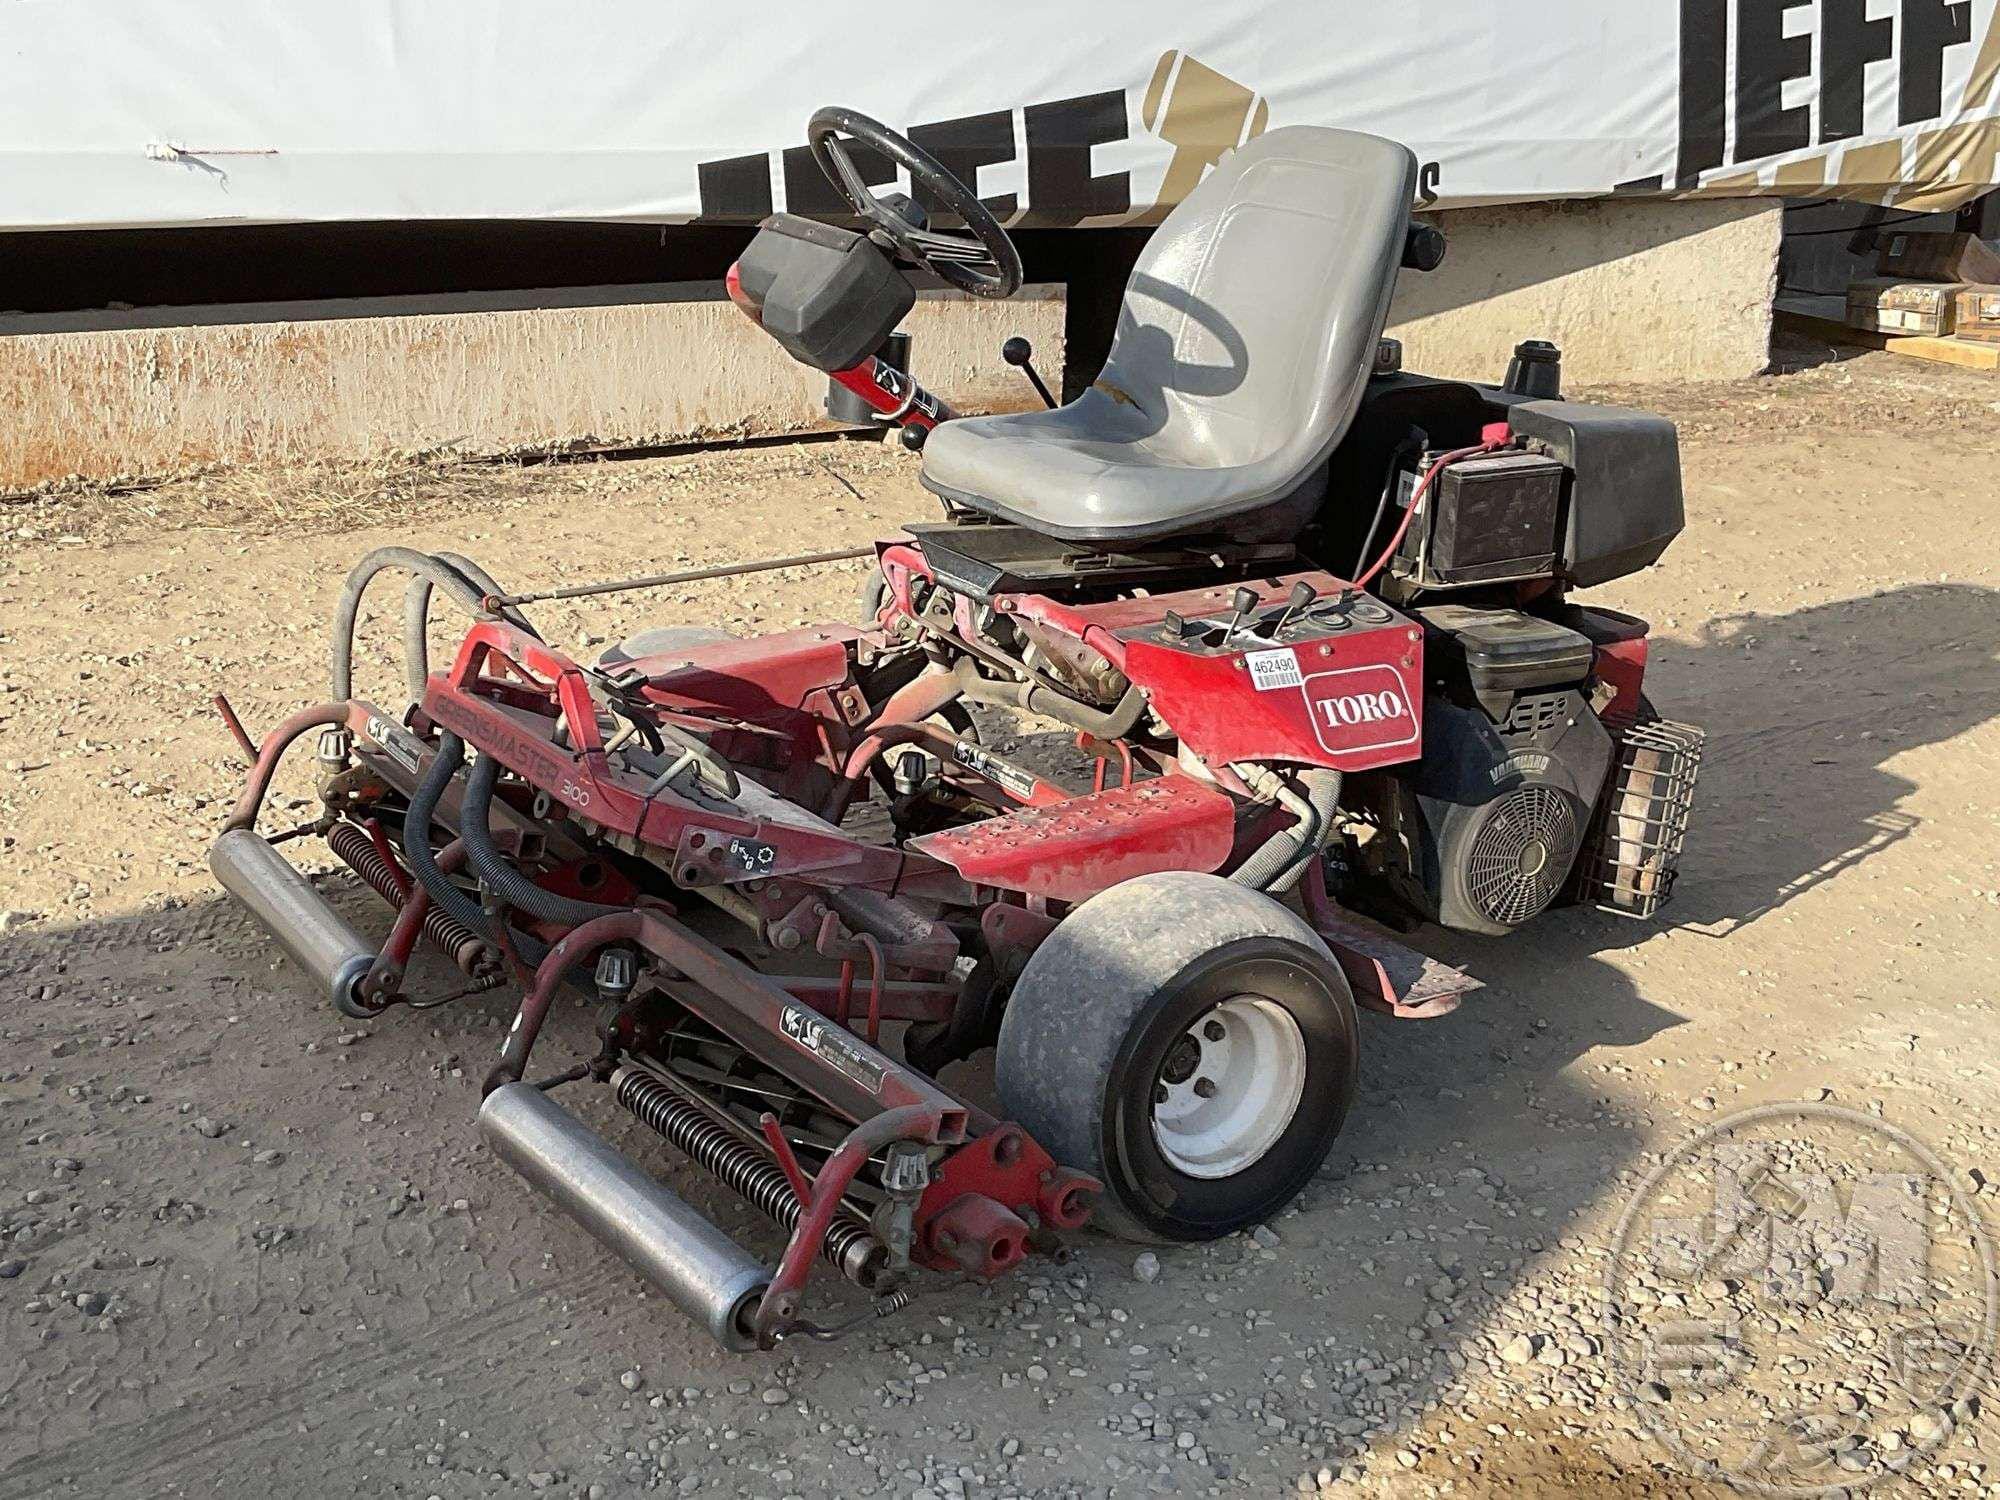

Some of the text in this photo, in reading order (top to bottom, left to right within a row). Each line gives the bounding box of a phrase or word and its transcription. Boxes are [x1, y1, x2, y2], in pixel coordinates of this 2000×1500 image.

[1254, 657, 1295, 674] 462490
[1316, 690, 1404, 728] TORO
[1489, 754, 1551, 782] VANGUARD
[560, 778, 590, 807] 3100
